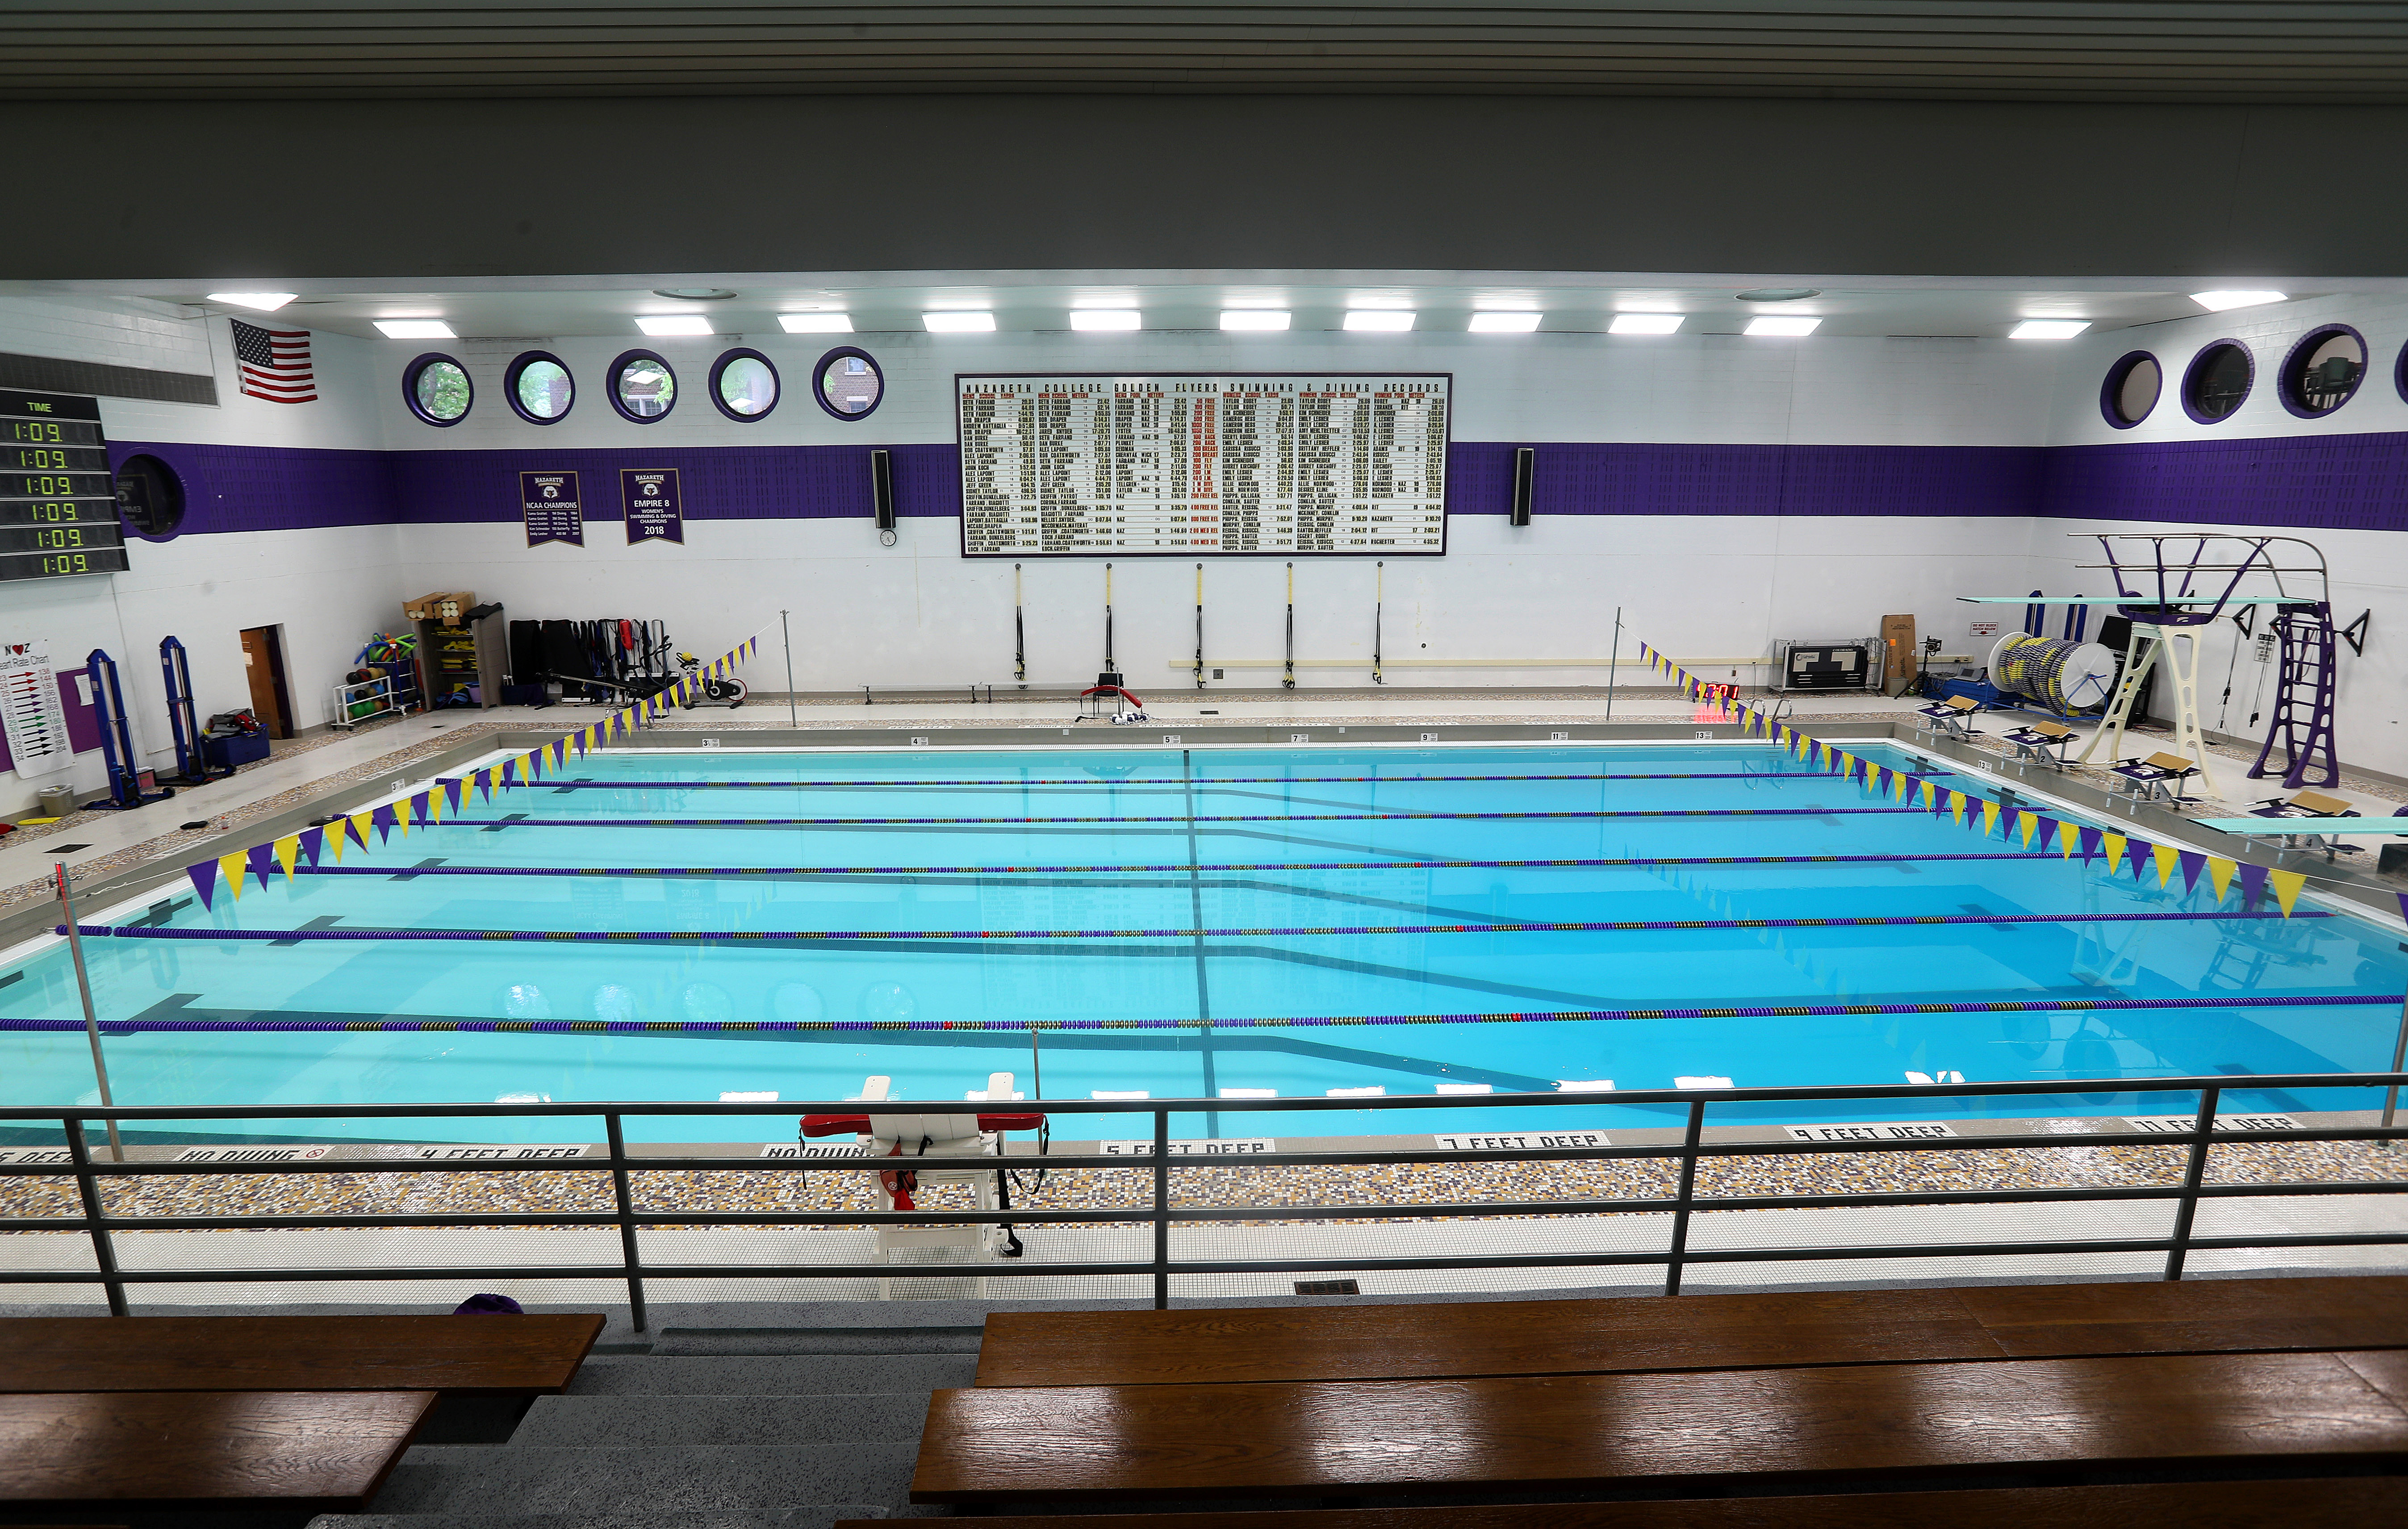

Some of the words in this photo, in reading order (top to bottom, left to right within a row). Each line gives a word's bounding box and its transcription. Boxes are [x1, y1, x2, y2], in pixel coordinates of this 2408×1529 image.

[1307, 383, 1311, 392] &
[27, 402, 52, 412] TIME
[644, 526, 664, 534] 2018
[0, 660, 13, 670] eart
[2306, 839, 2312, 847] 4
[2166, 1119, 2229, 1131] FET
[2232, 1118, 2293, 1130] DEEP
[1794, 1129, 1813, 1140] 9
[1820, 1128, 1878, 1140] FEET
[1887, 1126, 1946, 1138] DEEP
[1443, 1139, 1458, 1149] 7
[1469, 1137, 1525, 1149] FEET
[1541, 1135, 1599, 1147] DEEP
[422, 1149, 438, 1158] 4
[805, 1148, 867, 1157] DIVIN
[1134, 1144, 1191, 1154] FT
